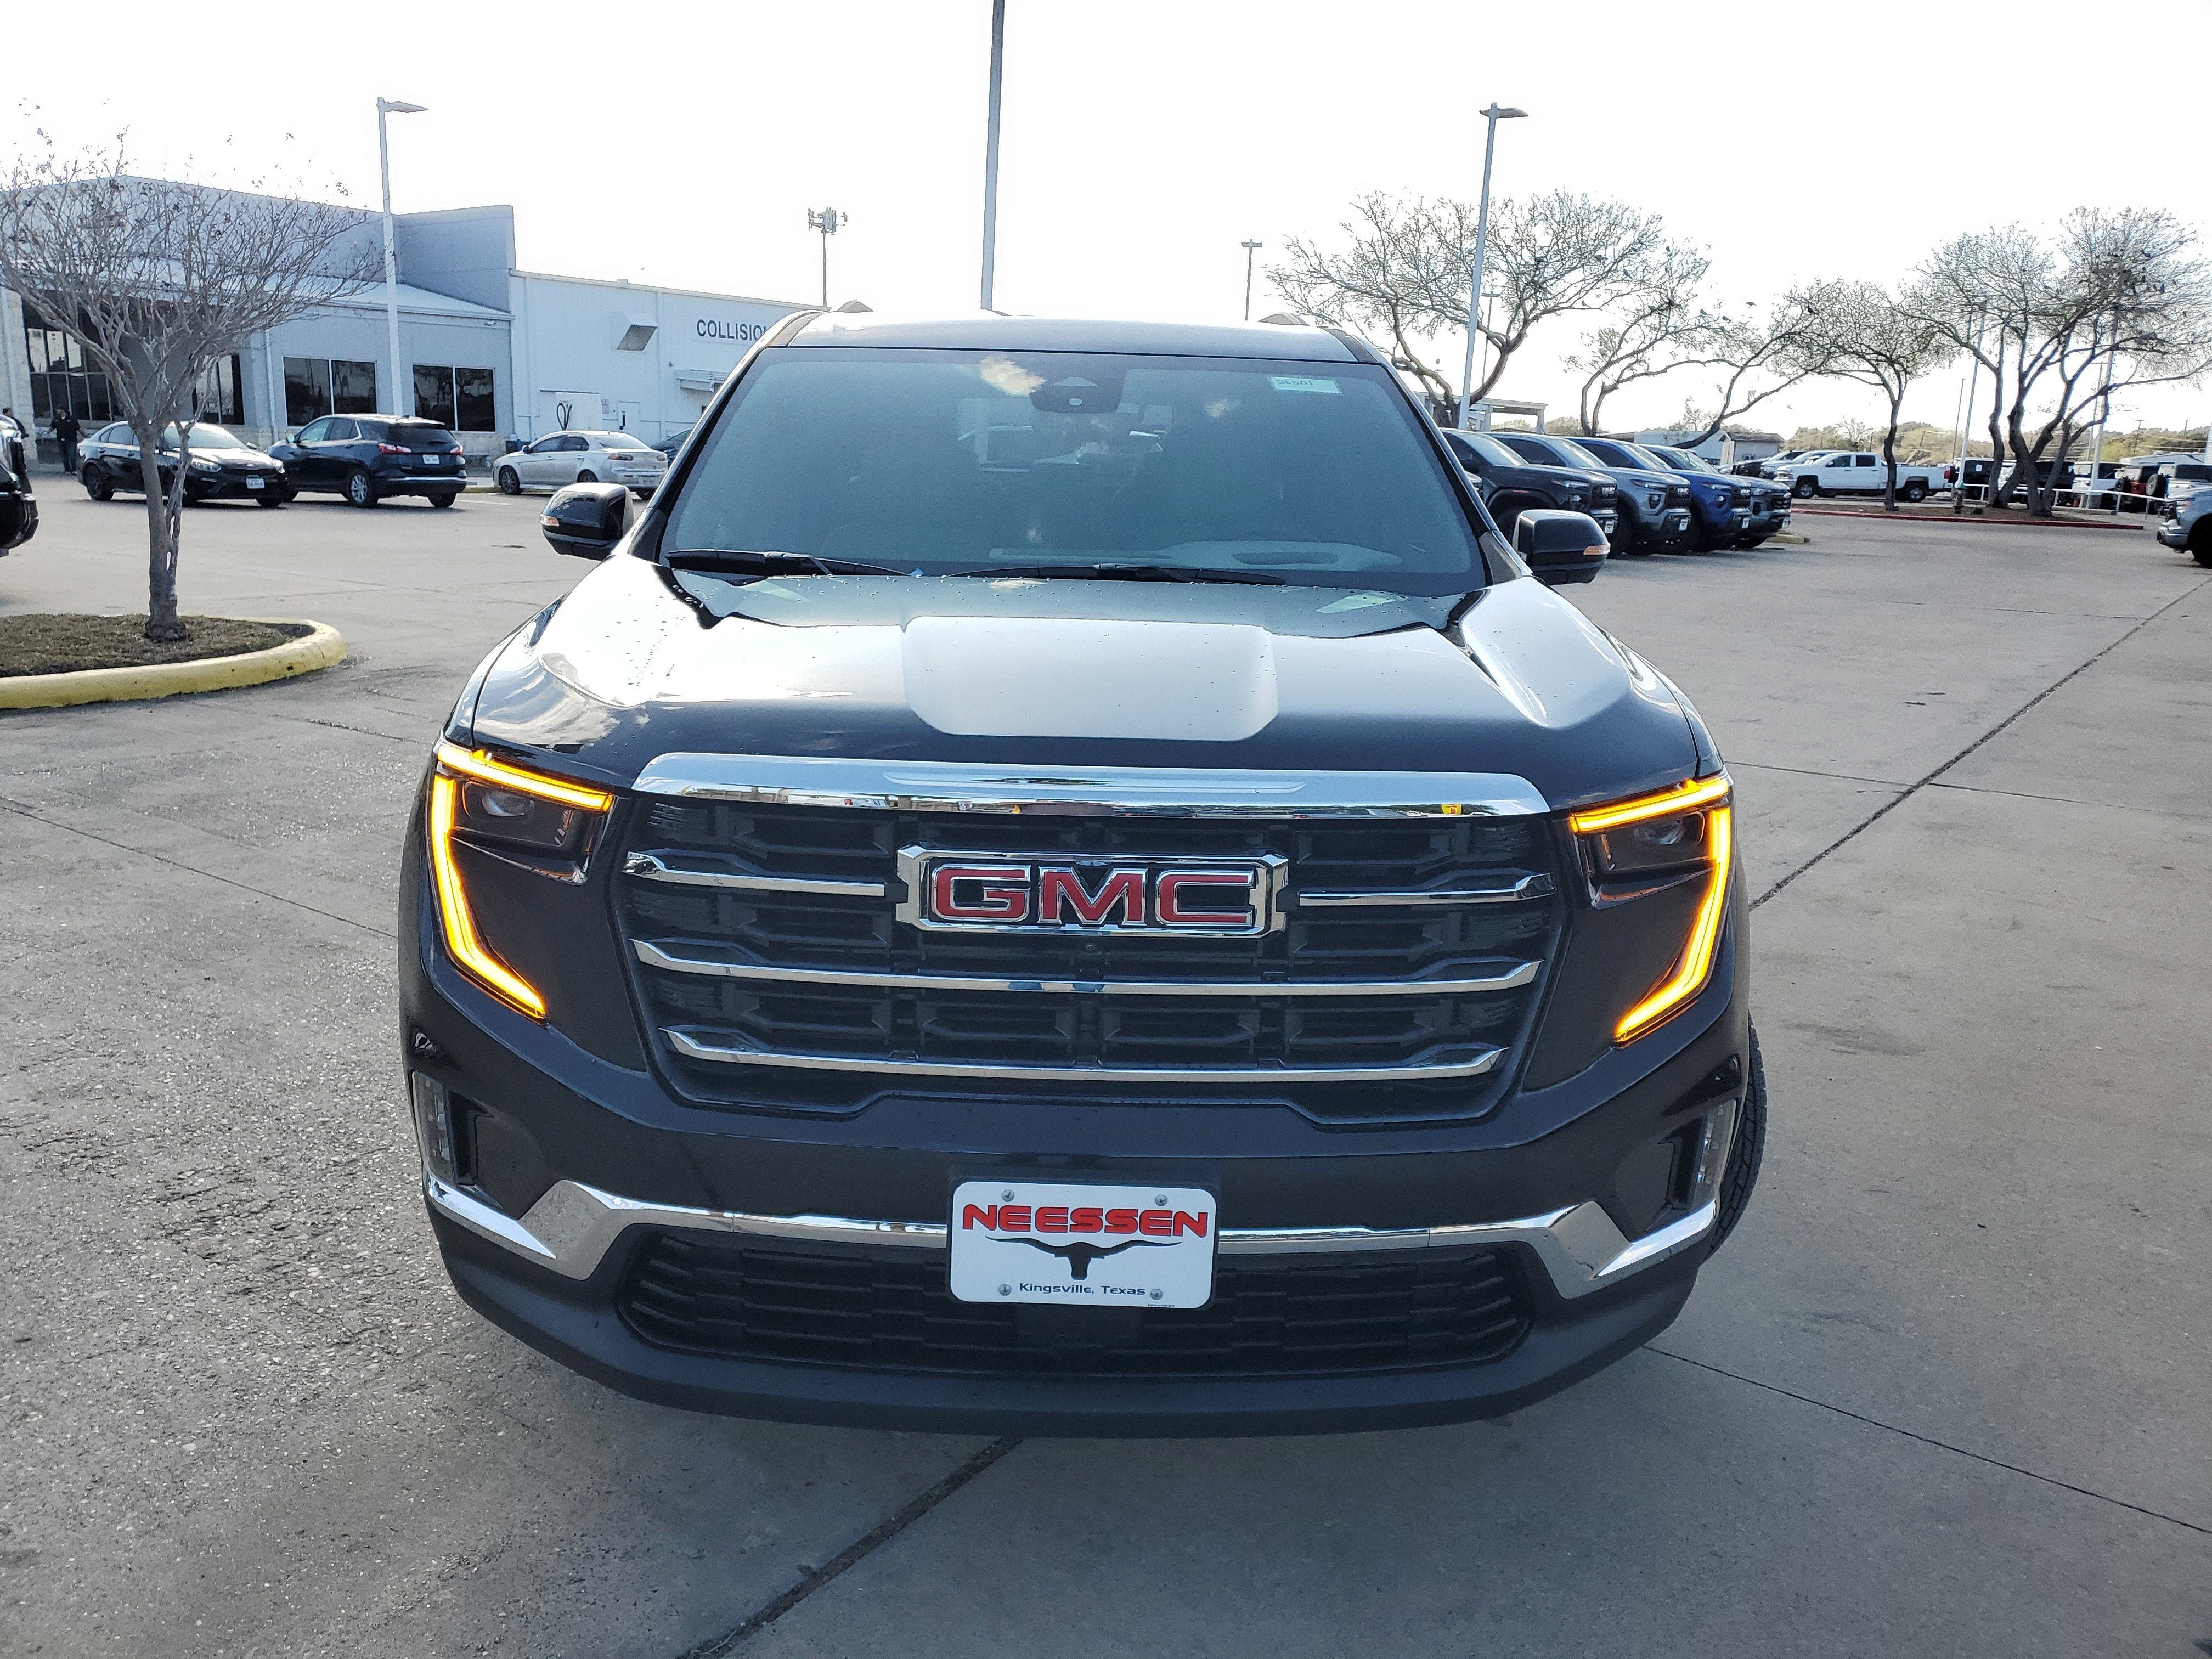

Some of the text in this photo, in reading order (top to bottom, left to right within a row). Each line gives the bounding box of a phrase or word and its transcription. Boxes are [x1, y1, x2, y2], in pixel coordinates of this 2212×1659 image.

[697, 319, 766, 341] COLLISIO
[931, 863, 1255, 927] GMC
[963, 1204, 1208, 1238] NEESSEN
[1019, 1283, 1146, 1295] Kingsville, Texas
